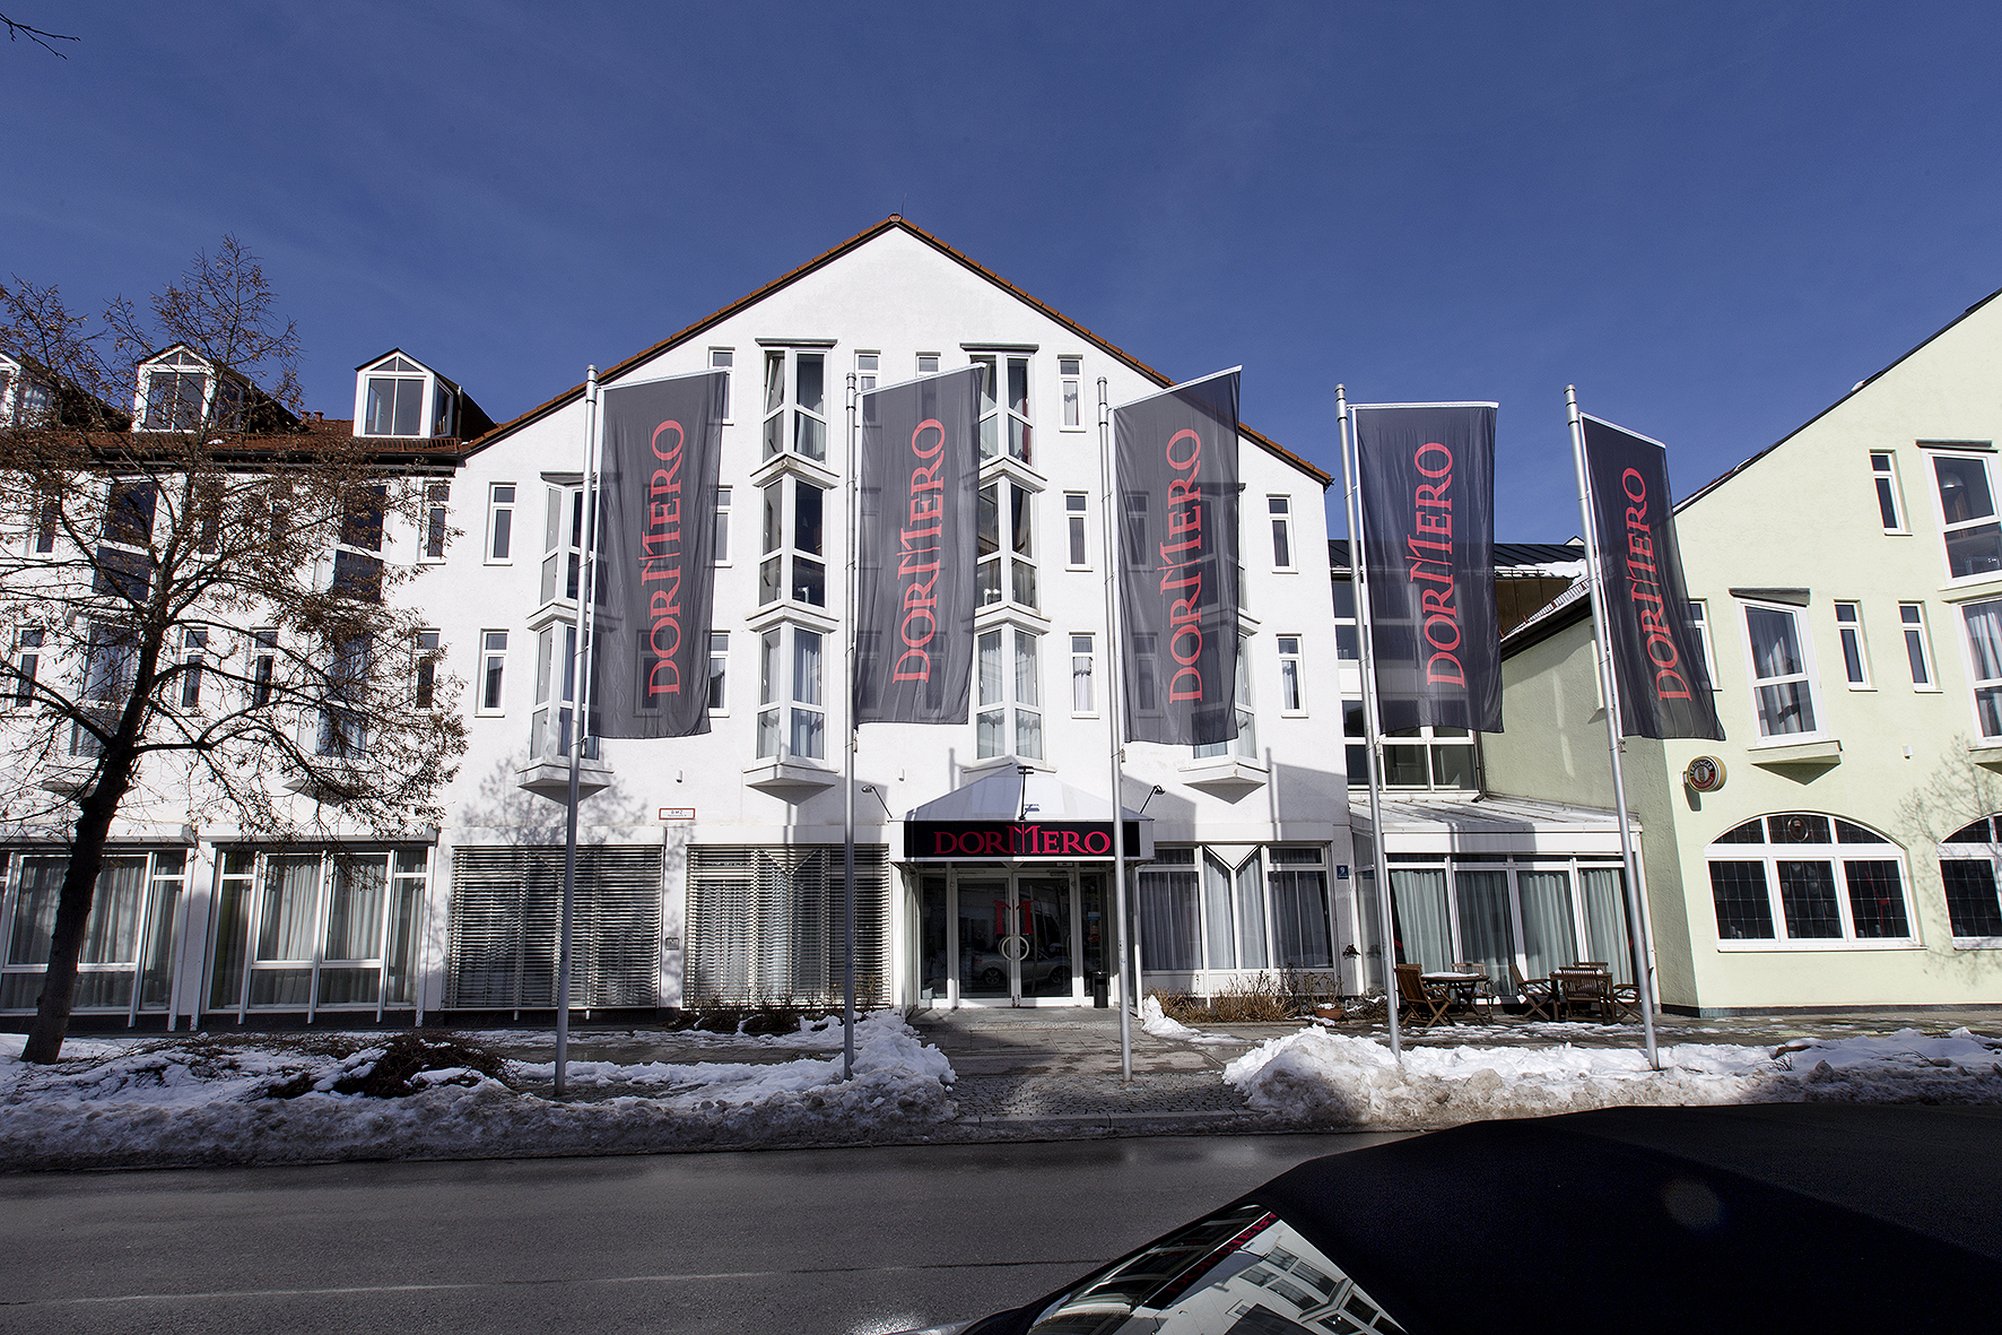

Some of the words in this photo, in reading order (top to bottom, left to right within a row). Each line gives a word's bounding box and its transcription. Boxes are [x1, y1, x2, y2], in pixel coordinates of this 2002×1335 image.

[639, 419, 684, 697] DORMERO
[892, 418, 945, 684] DORMERO
[1156, 428, 1202, 704] DORMERO
[1405, 442, 1466, 688] DORMERO
[1621, 467, 1692, 702] DORMERO
[934, 824, 1111, 854] DORMERO
